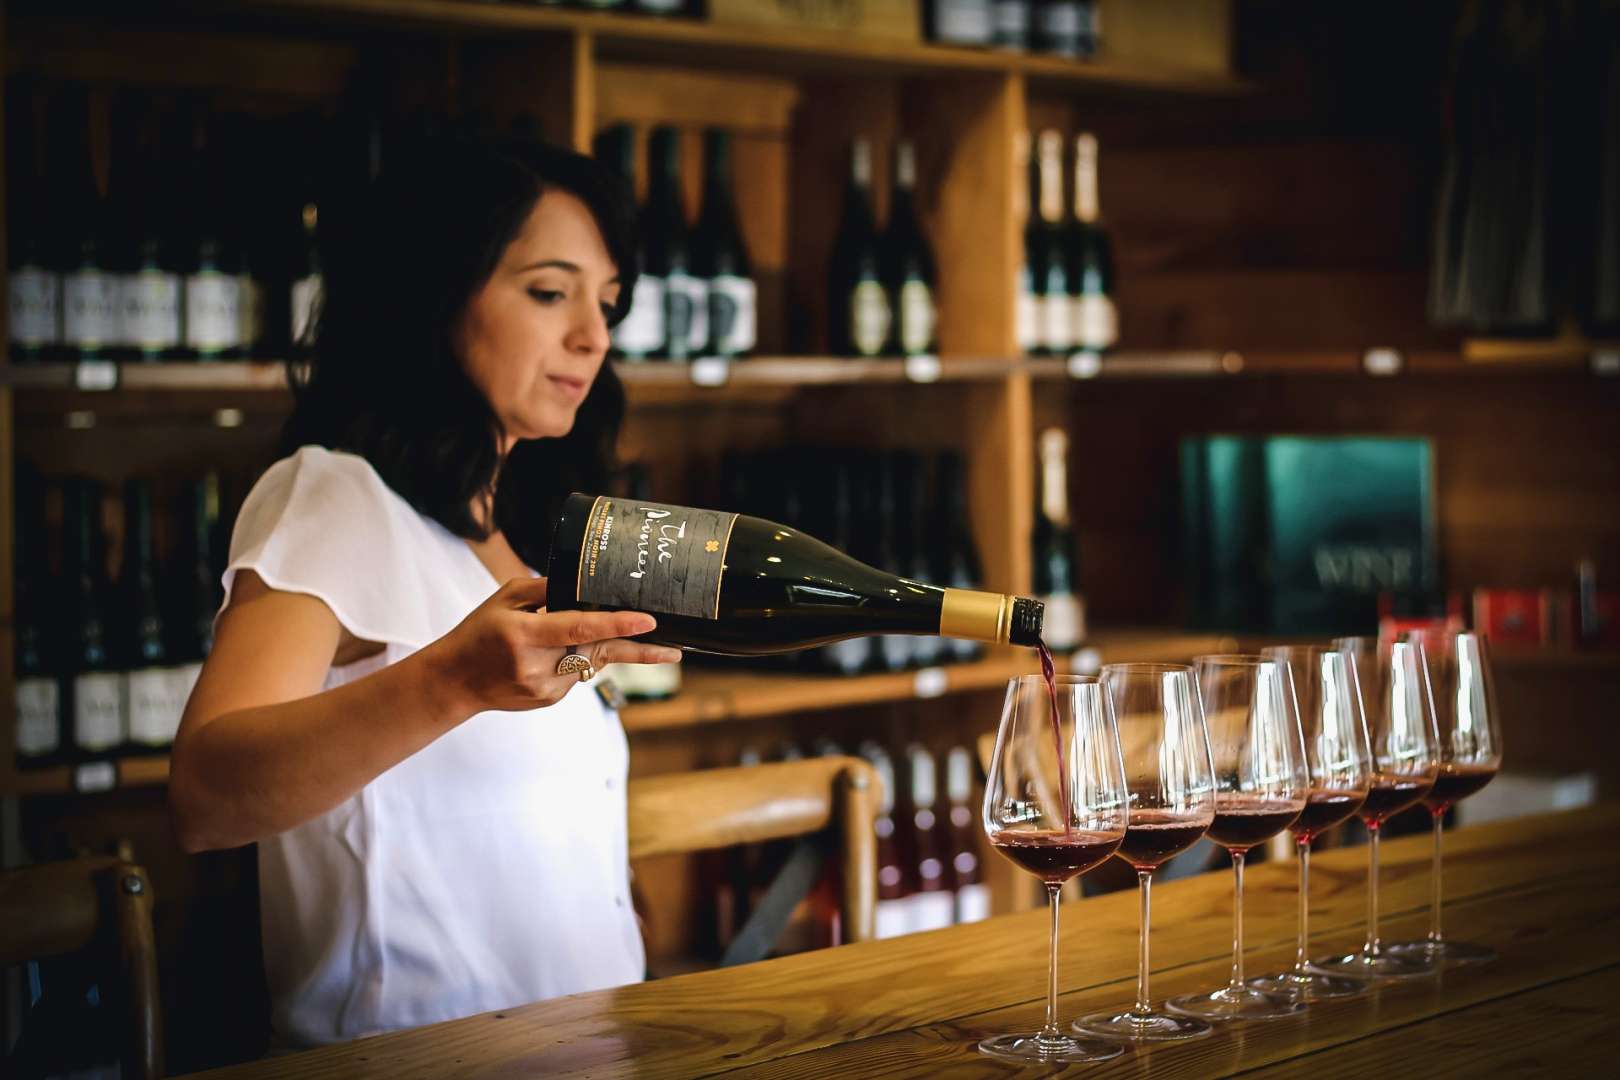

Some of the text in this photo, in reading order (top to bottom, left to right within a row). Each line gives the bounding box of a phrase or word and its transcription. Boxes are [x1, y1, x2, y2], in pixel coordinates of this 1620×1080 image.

[599, 516, 614, 551] KINROSS
[629, 507, 671, 578] Pioneer
[657, 520, 687, 563] The
